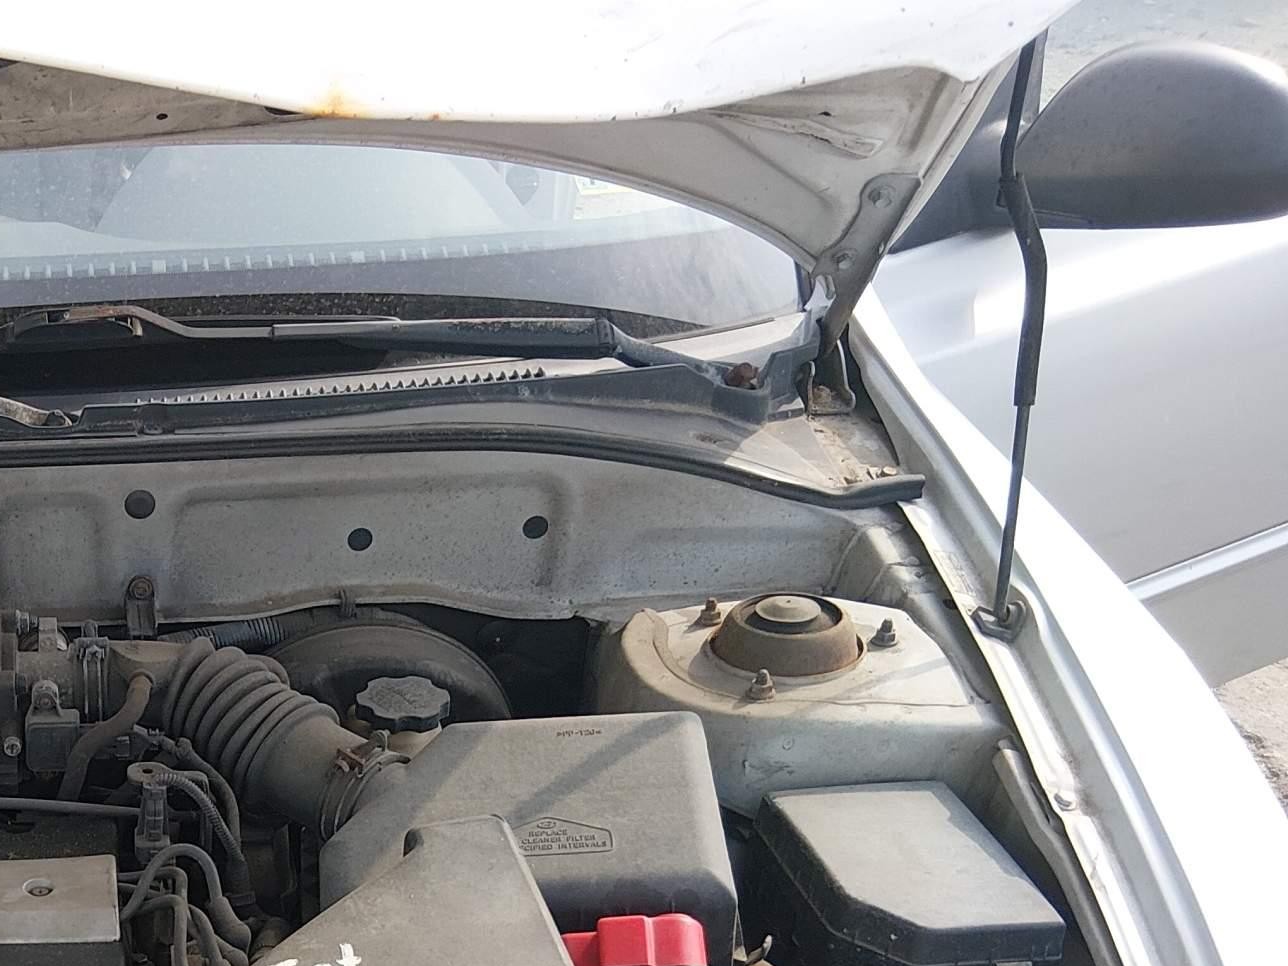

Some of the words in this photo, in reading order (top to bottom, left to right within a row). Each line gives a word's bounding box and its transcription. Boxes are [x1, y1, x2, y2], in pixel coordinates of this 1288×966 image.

[528, 828, 568, 838] REPLACE
[521, 835, 562, 845] CLEANER
[565, 834, 596, 842] FILTER
[558, 840, 607, 850] INTERVALS
